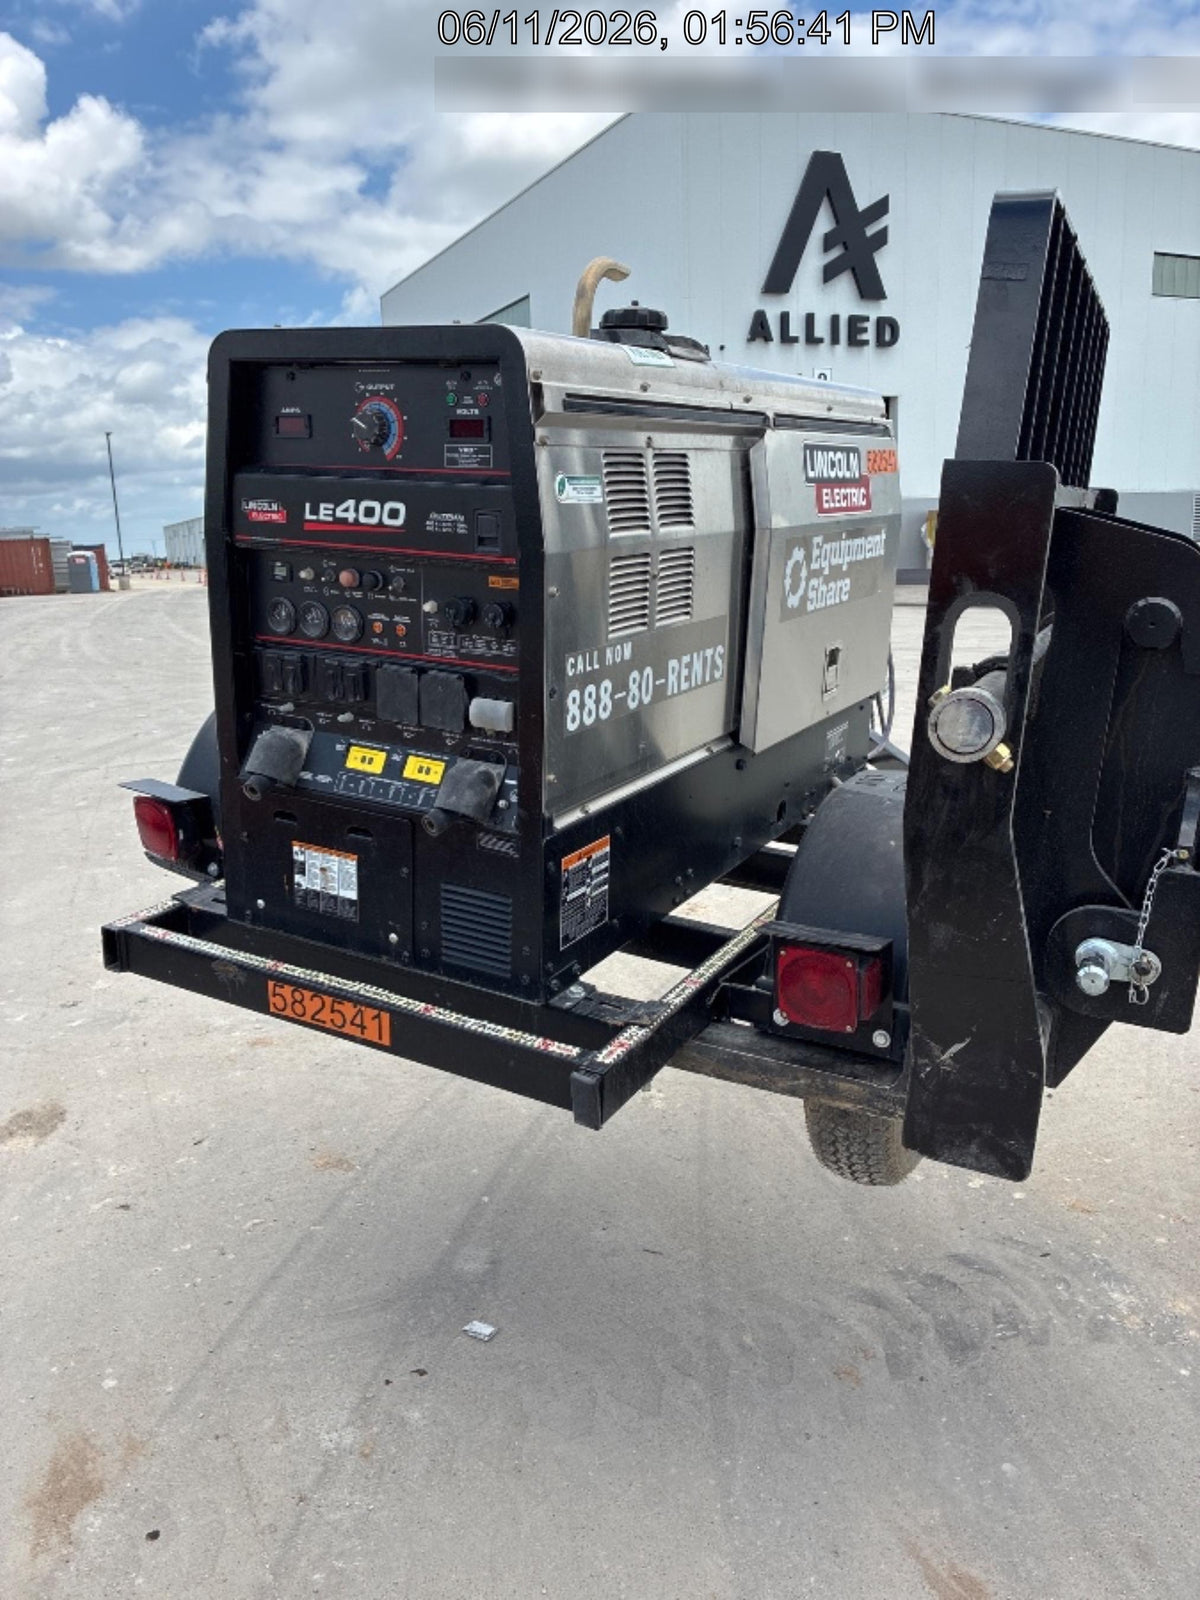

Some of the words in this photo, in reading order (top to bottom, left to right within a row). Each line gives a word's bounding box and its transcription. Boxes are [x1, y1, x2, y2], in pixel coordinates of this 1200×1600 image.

[747, 309, 901, 348] ALLIED
[806, 449, 859, 478] LINCOLN
[305, 499, 406, 526] LE400
[822, 487, 867, 509] ELECTRIC
[810, 528, 886, 575] Equipment
[806, 576, 851, 612] Share
[566, 650, 600, 677] CALL
[605, 641, 633, 666] NOW
[566, 644, 725, 732] 888-80-RENTS
[272, 982, 383, 1041] 582541
